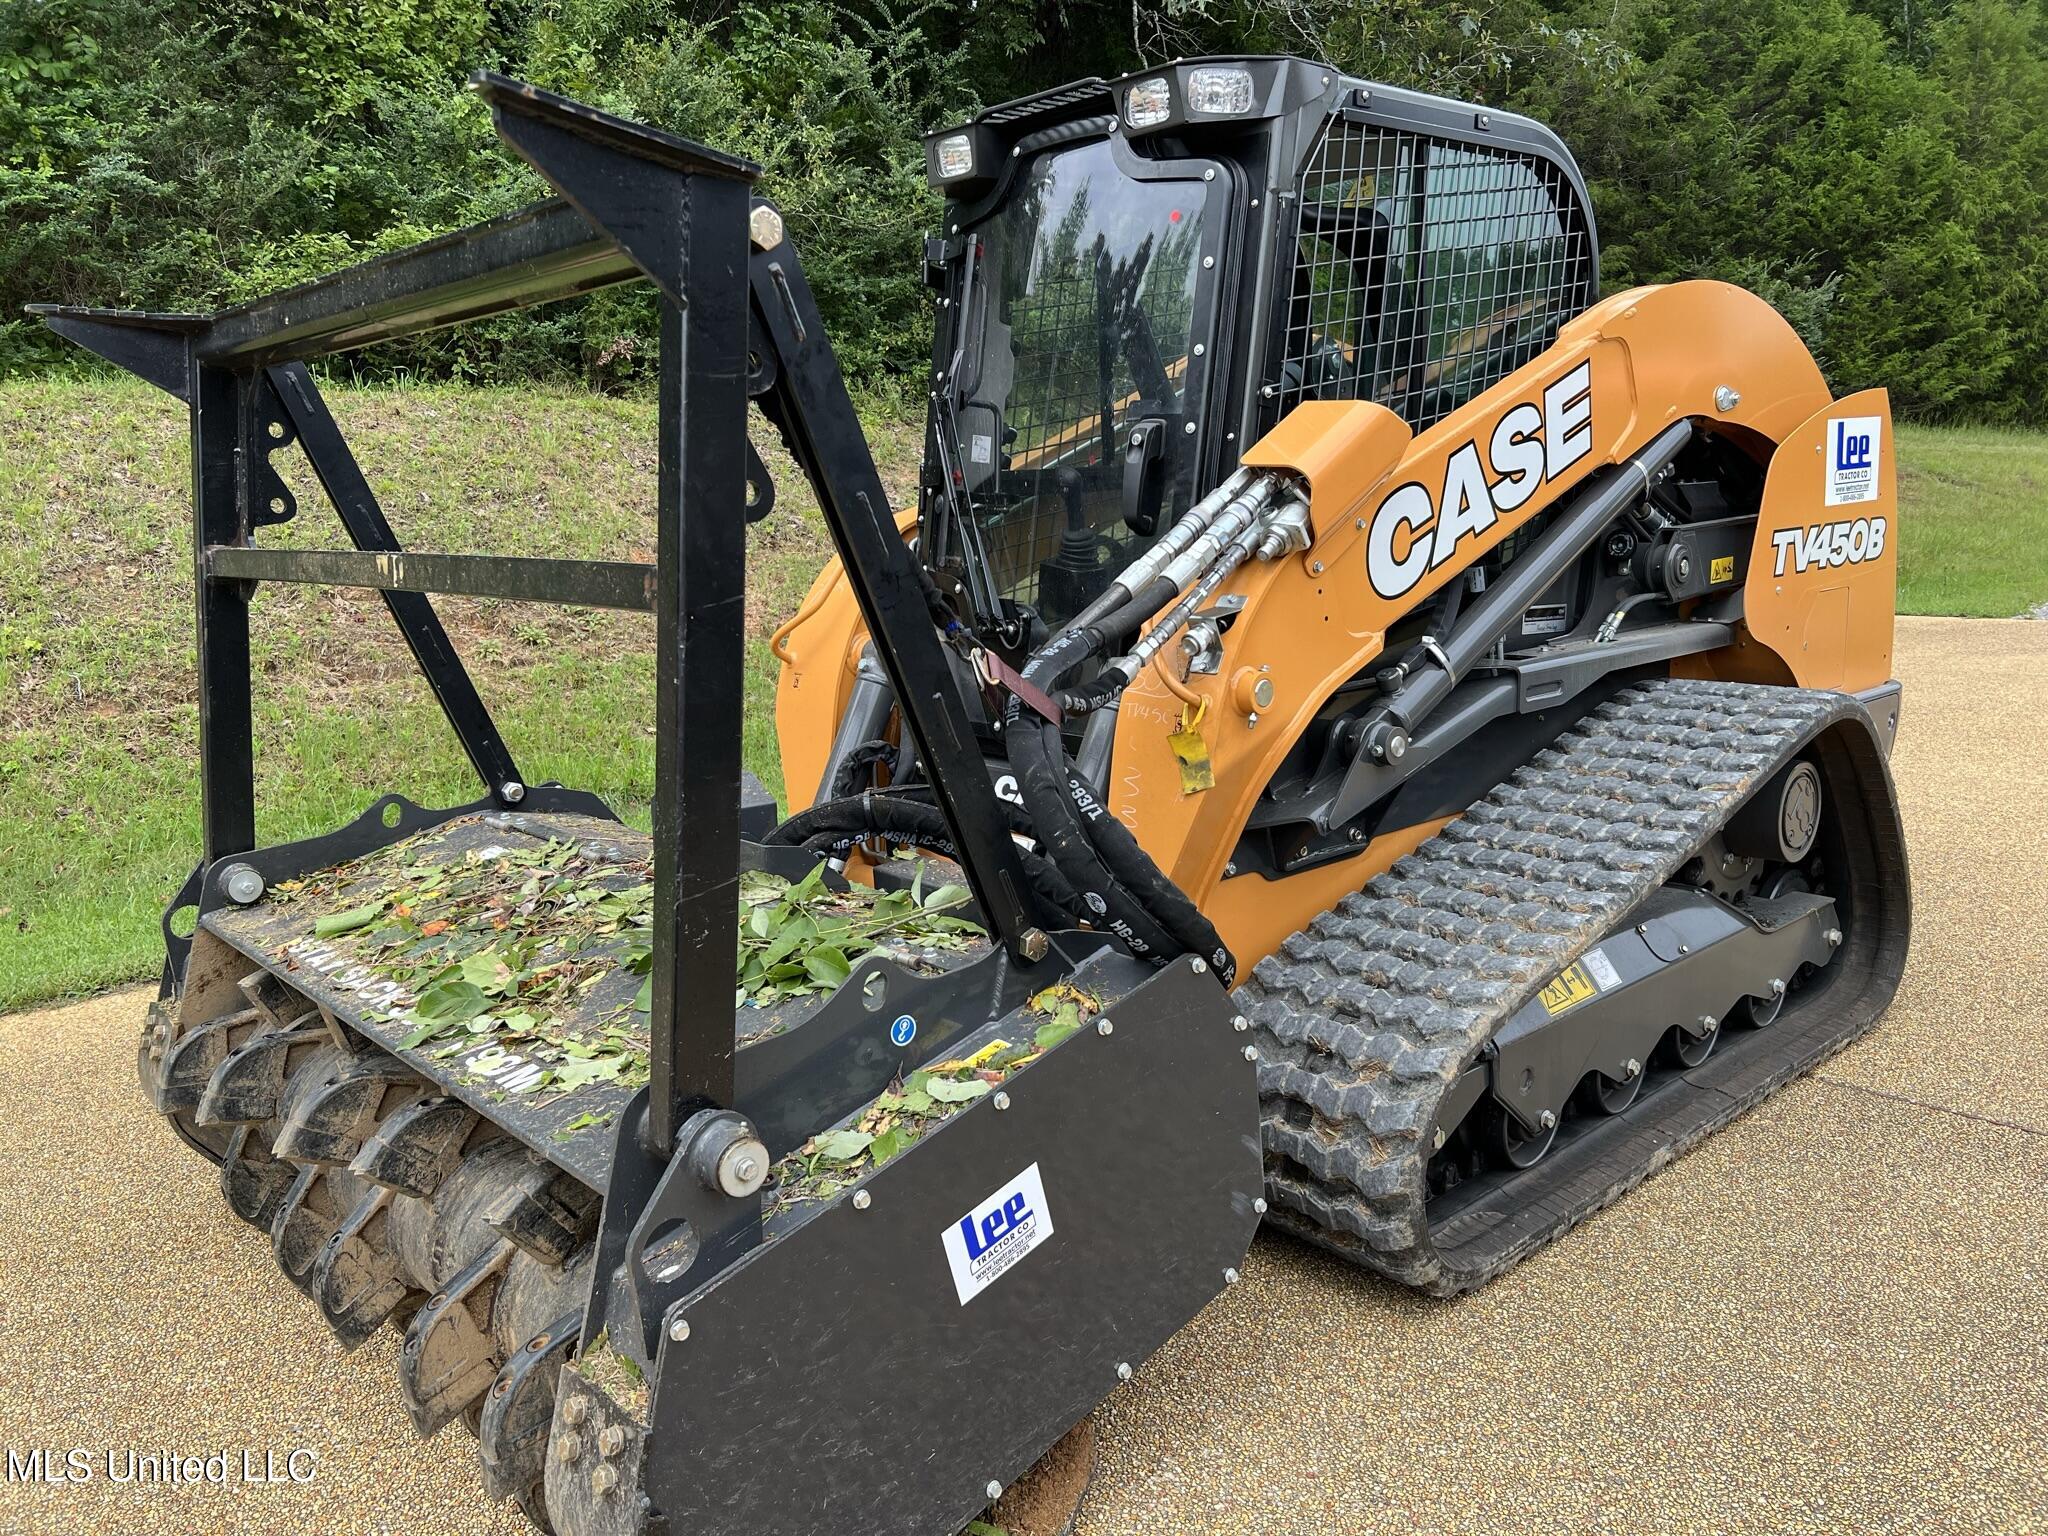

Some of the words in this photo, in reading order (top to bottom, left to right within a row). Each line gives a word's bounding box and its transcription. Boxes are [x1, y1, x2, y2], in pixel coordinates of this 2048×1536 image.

[1836, 421, 1871, 470] Lee
[1366, 357, 1592, 600] CASE
[1838, 471, 1860, 481] TRACTOR
[1861, 470, 1868, 478] CO
[1771, 516, 1887, 578] TV450B
[960, 1191, 1033, 1261] Lee
[976, 1232, 1015, 1267] TRACTOR
[1017, 1221, 1029, 1235] CO
